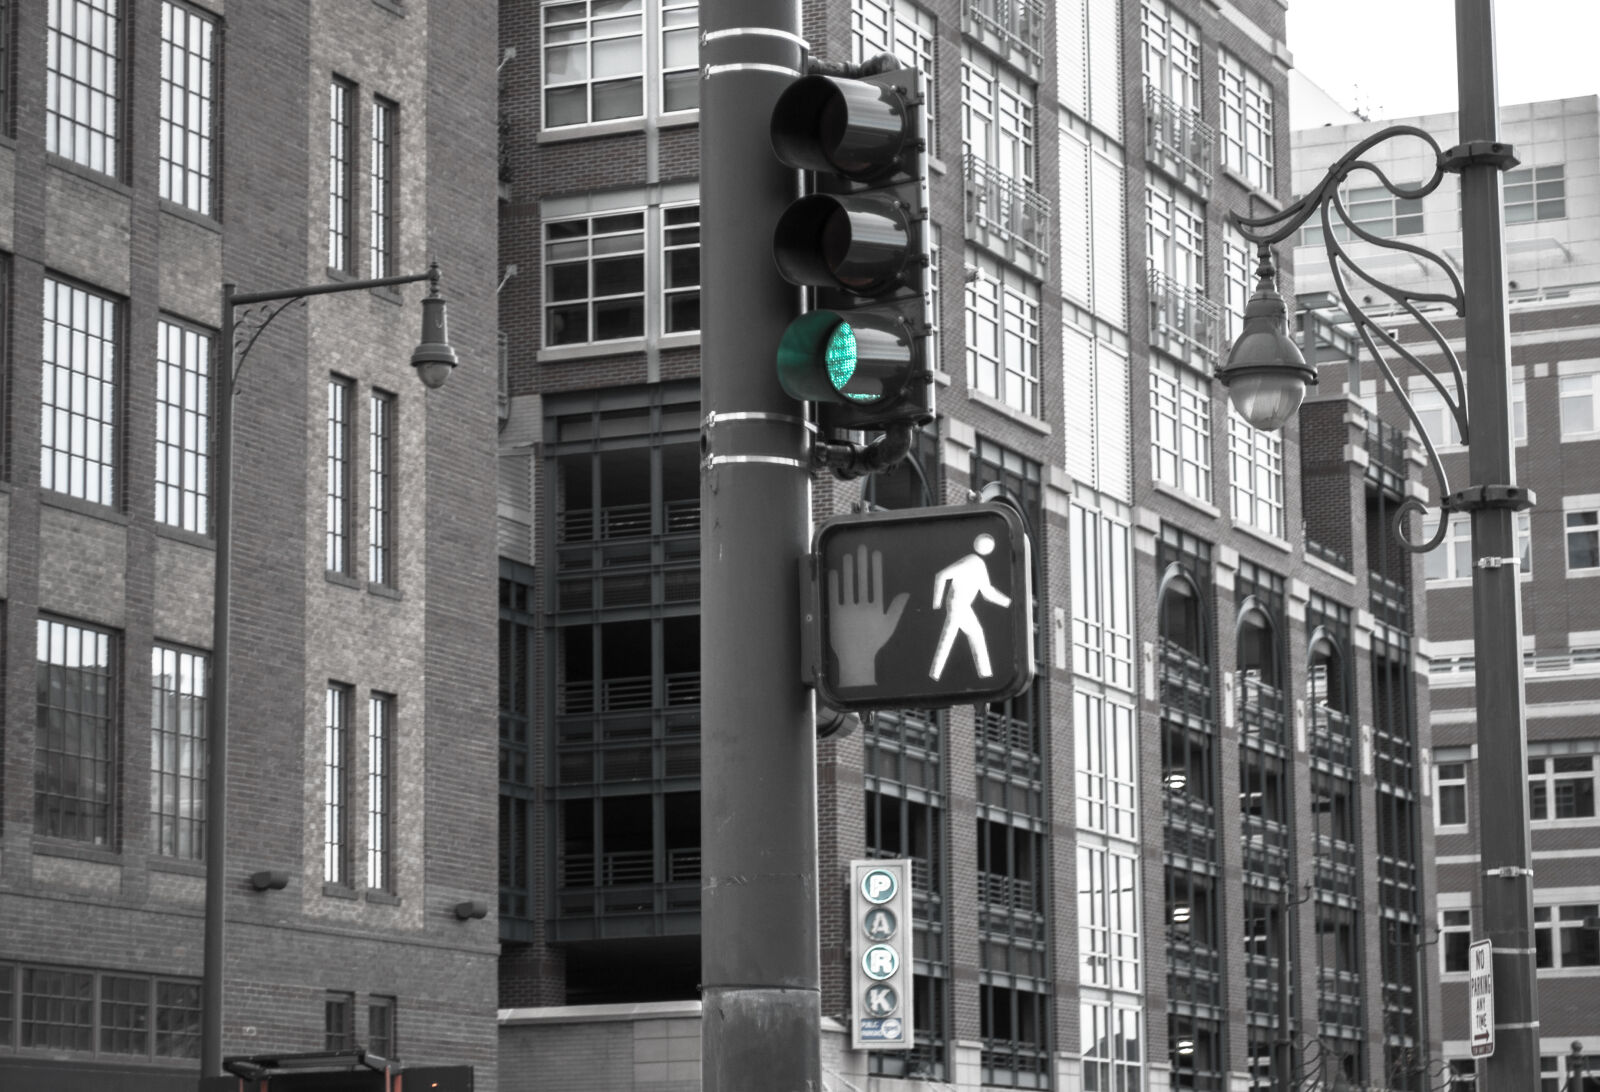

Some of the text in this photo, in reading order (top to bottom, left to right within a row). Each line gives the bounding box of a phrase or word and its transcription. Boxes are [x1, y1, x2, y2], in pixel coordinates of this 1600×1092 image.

[868, 873, 893, 1013] PARK
[1475, 949, 1485, 970] NO
[1471, 974, 1491, 997] PARKING
[1476, 997, 1486, 1011] ANY
[1475, 1013, 1487, 1030] TIME
